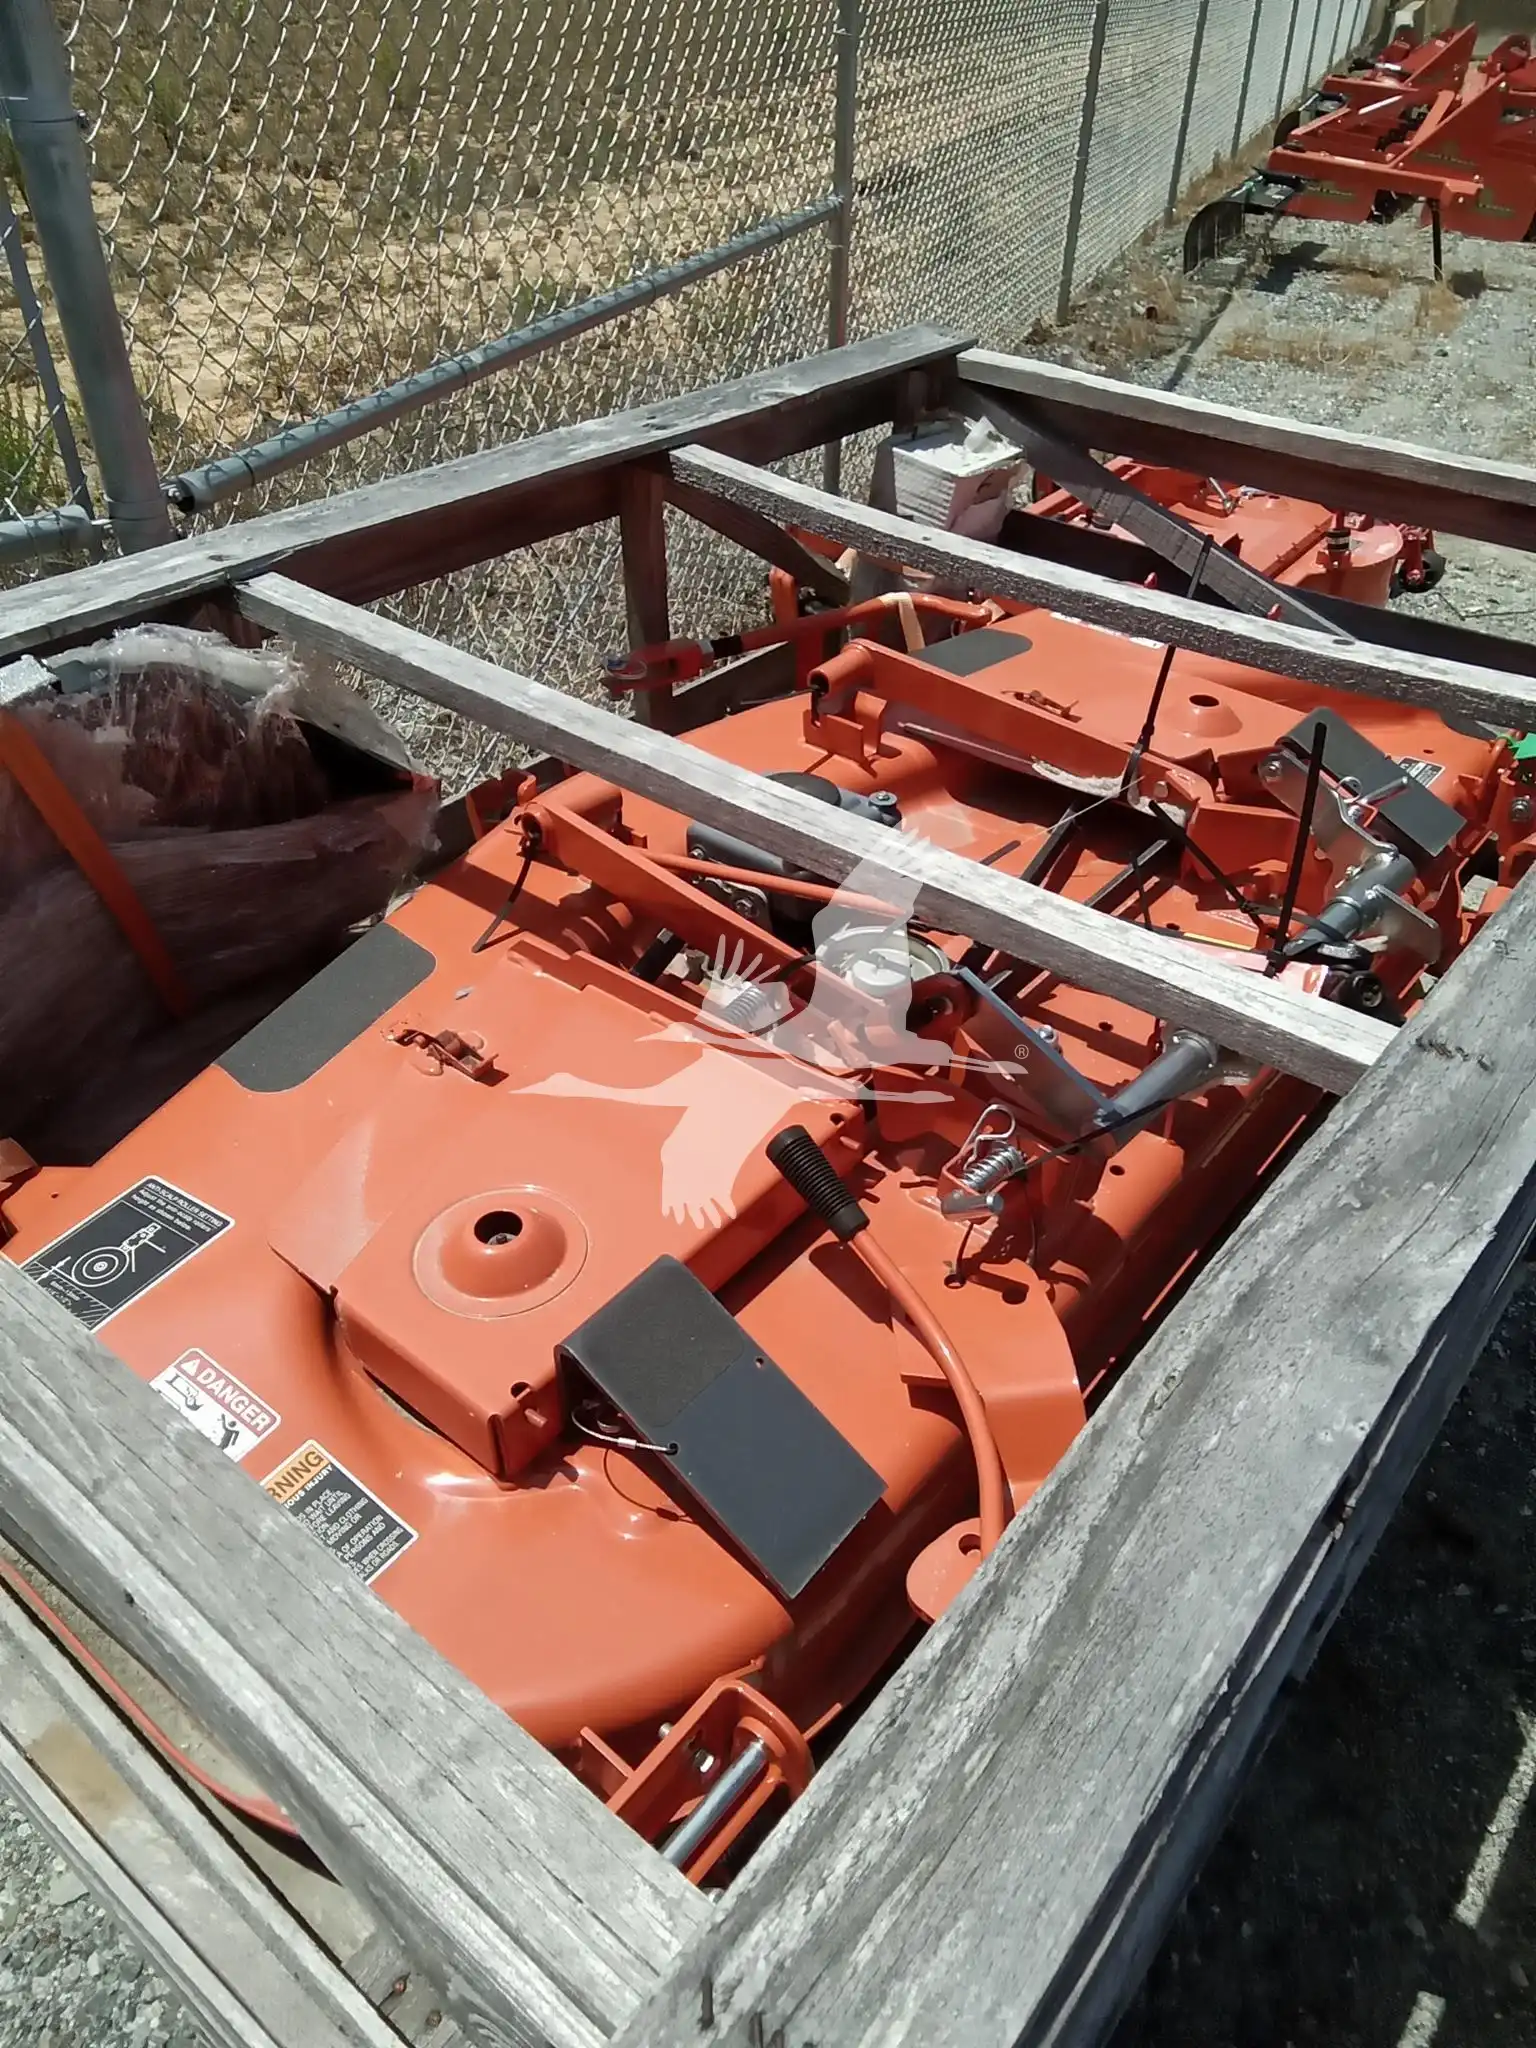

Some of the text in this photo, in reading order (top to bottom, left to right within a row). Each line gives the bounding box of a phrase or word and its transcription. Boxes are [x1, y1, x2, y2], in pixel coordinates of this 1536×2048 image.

[176, 1200, 199, 1212] ROLLER
[197, 1211, 223, 1225] SETTING
[197, 1367, 271, 1431] DANGER
[266, 1451, 324, 1498] RNING
[284, 1464, 333, 1509] IOUS INJURY
[307, 1505, 325, 1520] WAIT
[323, 1489, 344, 1506] UNTIL
[324, 1492, 352, 1516] LEAVING
[324, 1521, 340, 1535] AND
[337, 1496, 368, 1523] CLOTHING
[326, 1521, 353, 1545] MOVING
[349, 1512, 362, 1523] OR
[340, 1543, 350, 1552] OF
[349, 1513, 384, 1544] OPERATION
[342, 1533, 373, 1560] PERSONS
[371, 1521, 386, 1535] AND
[360, 1549, 379, 1565] WHEN
[375, 1526, 404, 1551] CROSSING
